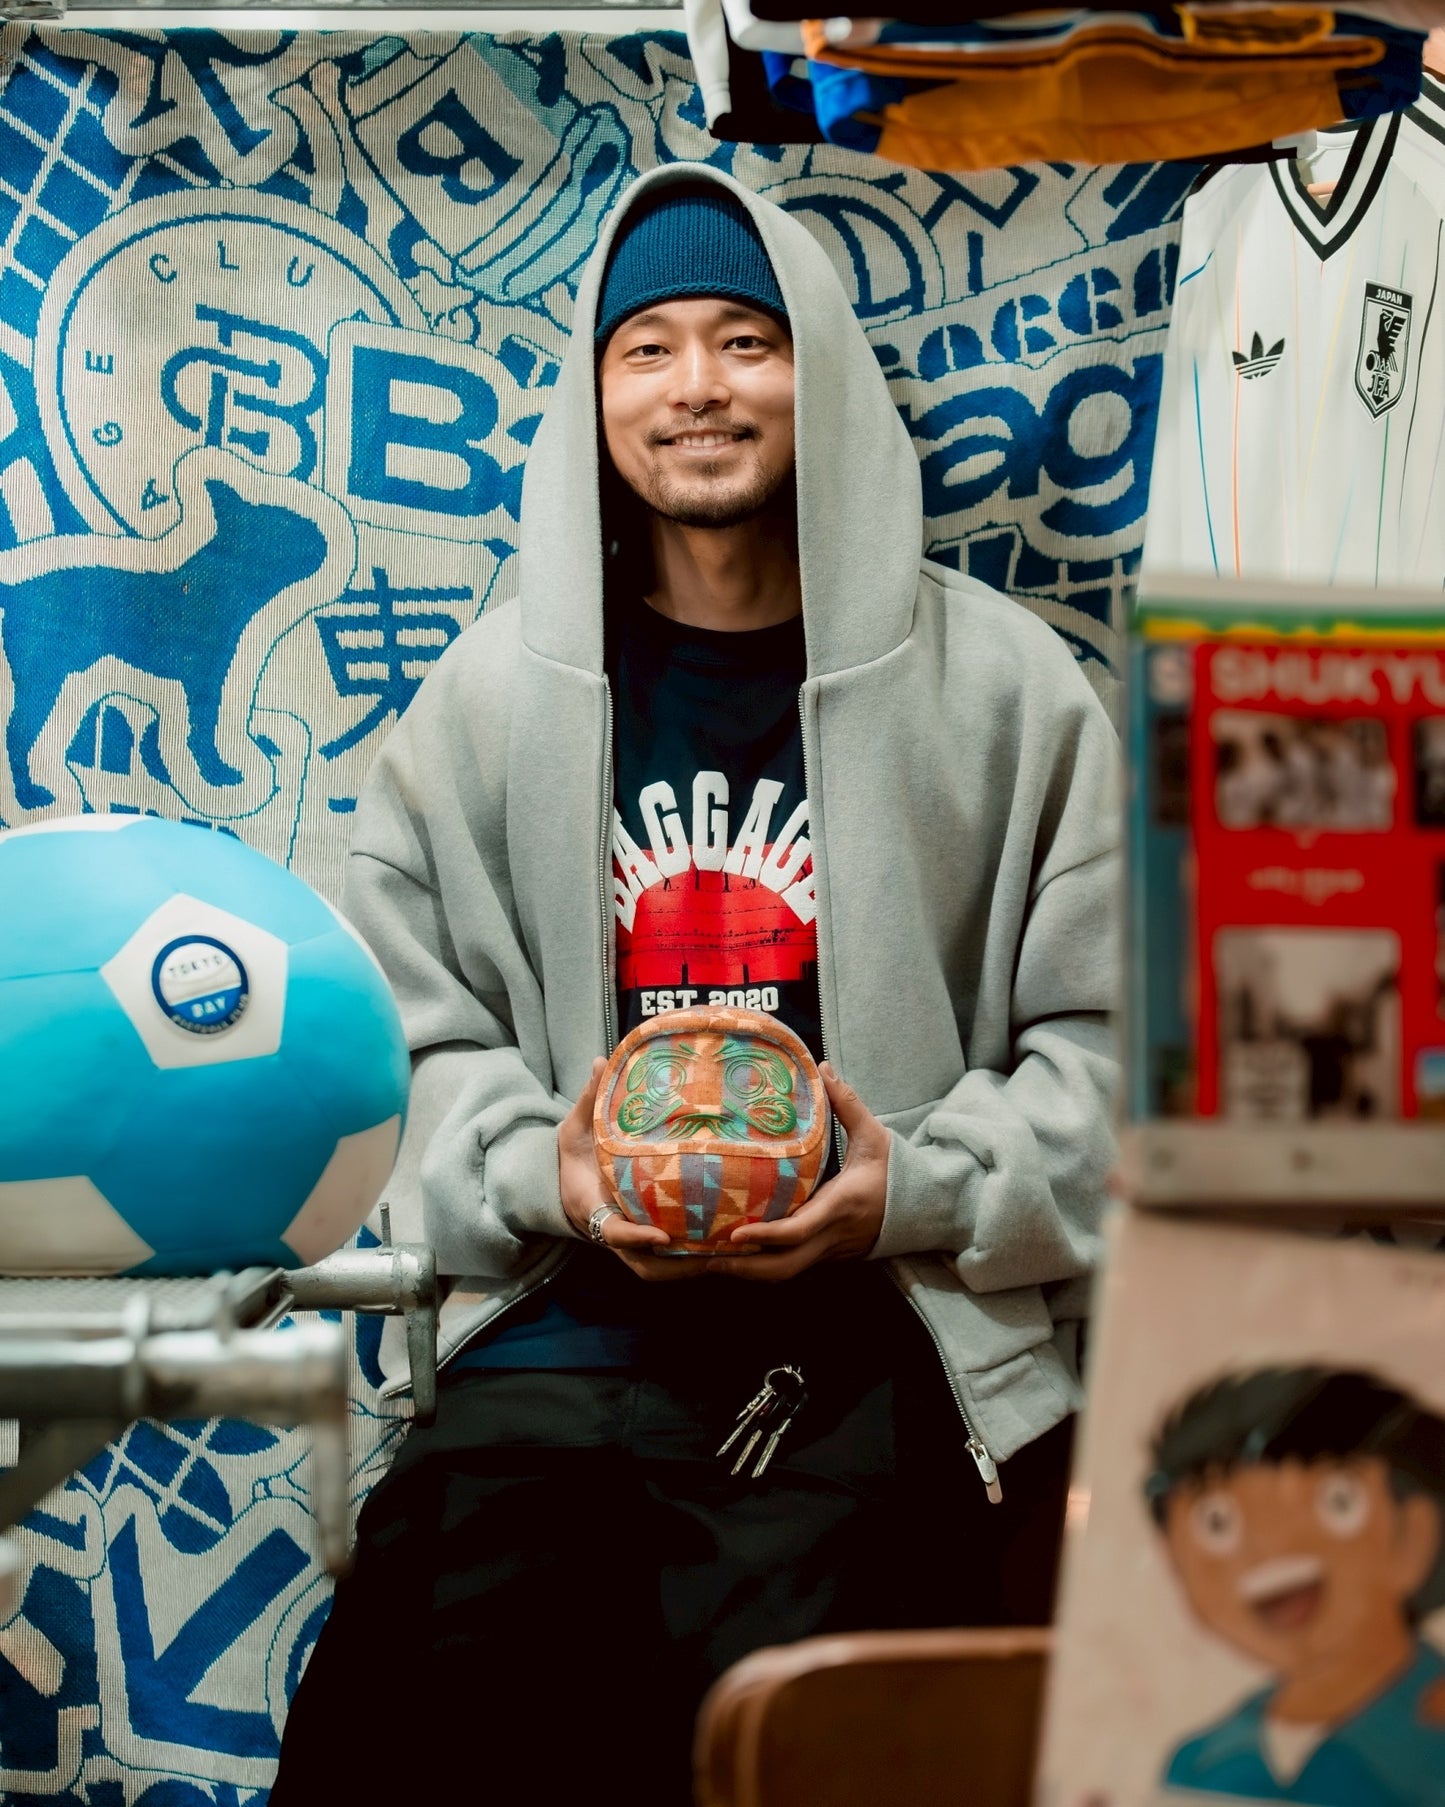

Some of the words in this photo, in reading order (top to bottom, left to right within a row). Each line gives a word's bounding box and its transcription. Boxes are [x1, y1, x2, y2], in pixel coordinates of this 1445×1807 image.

[1375, 288, 1403, 306] JAPAN
[1367, 376, 1390, 399] JFA
[191, 997, 226, 1018] BAY
[641, 988, 697, 1016] EST
[708, 987, 779, 1012] 2020
